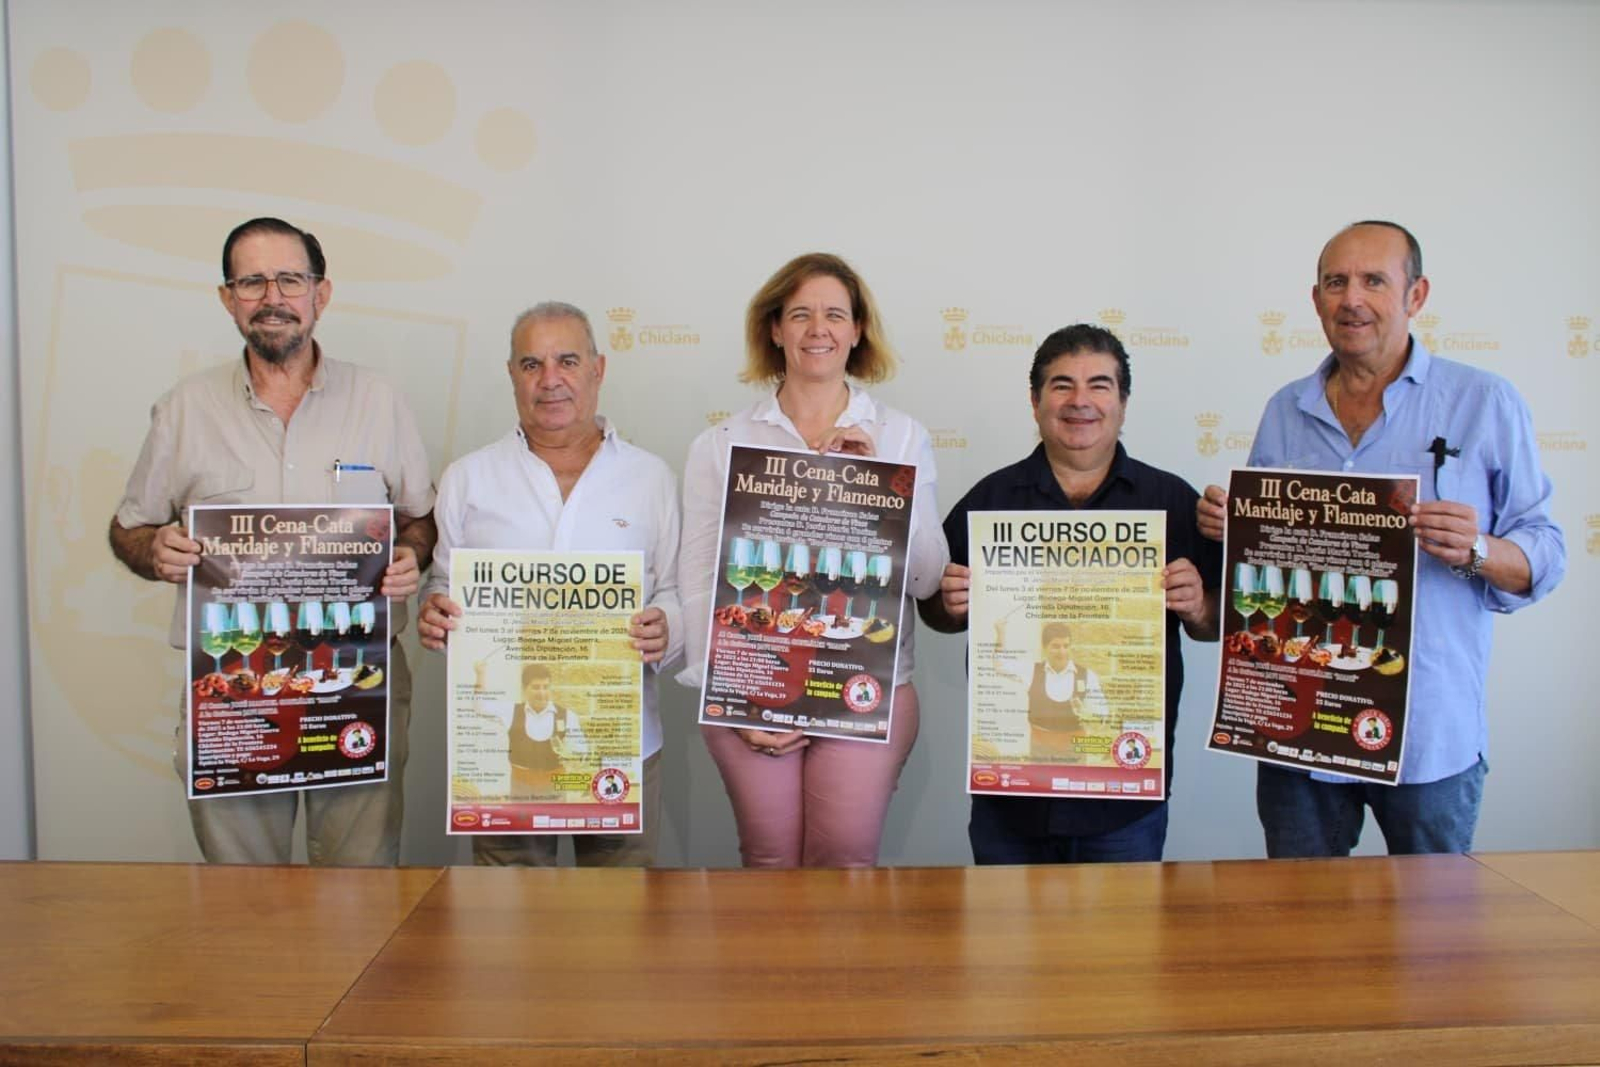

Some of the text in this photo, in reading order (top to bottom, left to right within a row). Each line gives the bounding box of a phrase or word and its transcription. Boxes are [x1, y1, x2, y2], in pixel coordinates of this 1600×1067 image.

[764, 456, 879, 486] III Cena-Cata
[735, 474, 904, 509] Maridaje y Flamenco
[1260, 479, 1375, 505] III Cena-Cata
[231, 515, 353, 534] III Cena-Cata
[1235, 498, 1406, 529] Maridaje y Flamenco
[993, 521, 1147, 542] III CURSO DE
[203, 536, 382, 559] Maridaje y Flamenco
[982, 545, 1157, 567] VENENCIADOR
[474, 562, 626, 584] III CURSO DE
[462, 586, 636, 609] VENENCIADOR
